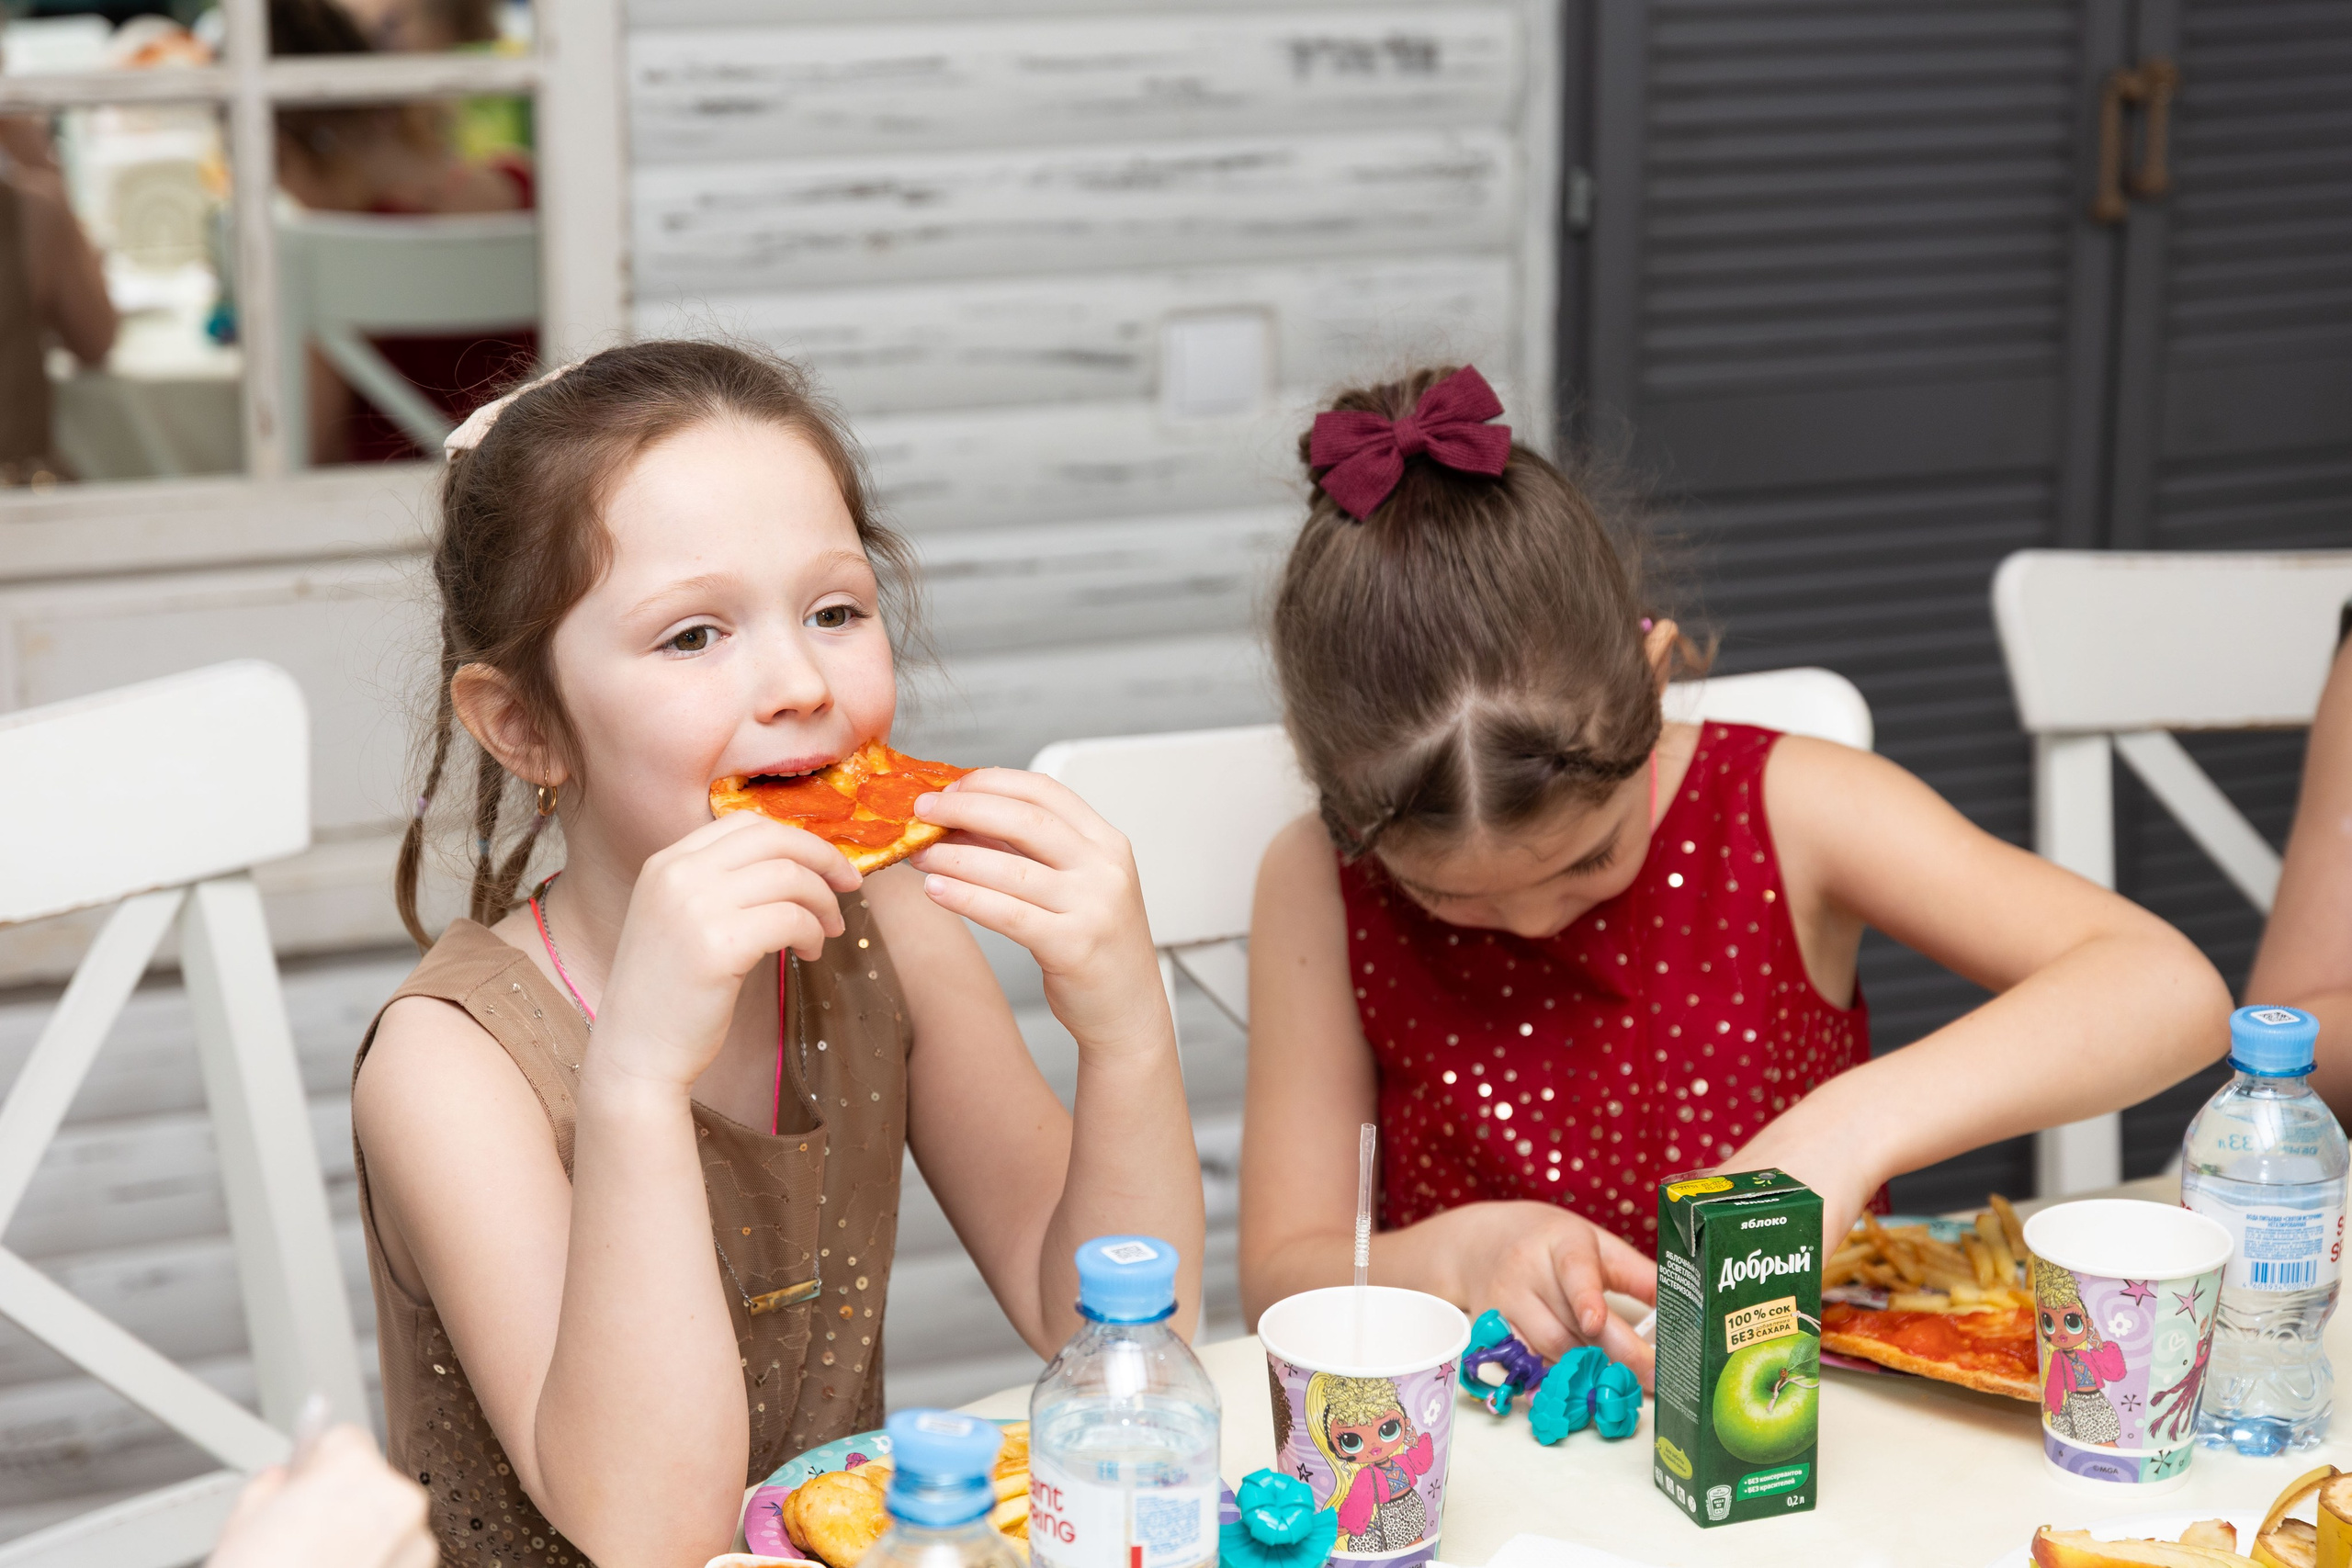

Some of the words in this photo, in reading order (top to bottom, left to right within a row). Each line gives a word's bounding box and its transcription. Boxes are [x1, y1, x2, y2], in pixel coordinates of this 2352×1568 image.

[1740, 1216, 1787, 1230] яблоко
[1717, 1246, 1811, 1293] Добрый
[1728, 1312, 1752, 1329] 100
[1753, 1308, 1767, 1320] %
[1731, 1328, 1754, 1346] БЕЗ
[1756, 1324, 1791, 1337] САХАРА
[1747, 1477, 1758, 1485] БЕЗ
[1759, 1470, 1803, 1483] консервантов
[1747, 1485, 1758, 1494] БЕЗ
[1759, 1478, 1795, 1492] красителей
[1786, 1495, 1799, 1508] 0,2
[1799, 1495, 1805, 1504] л
